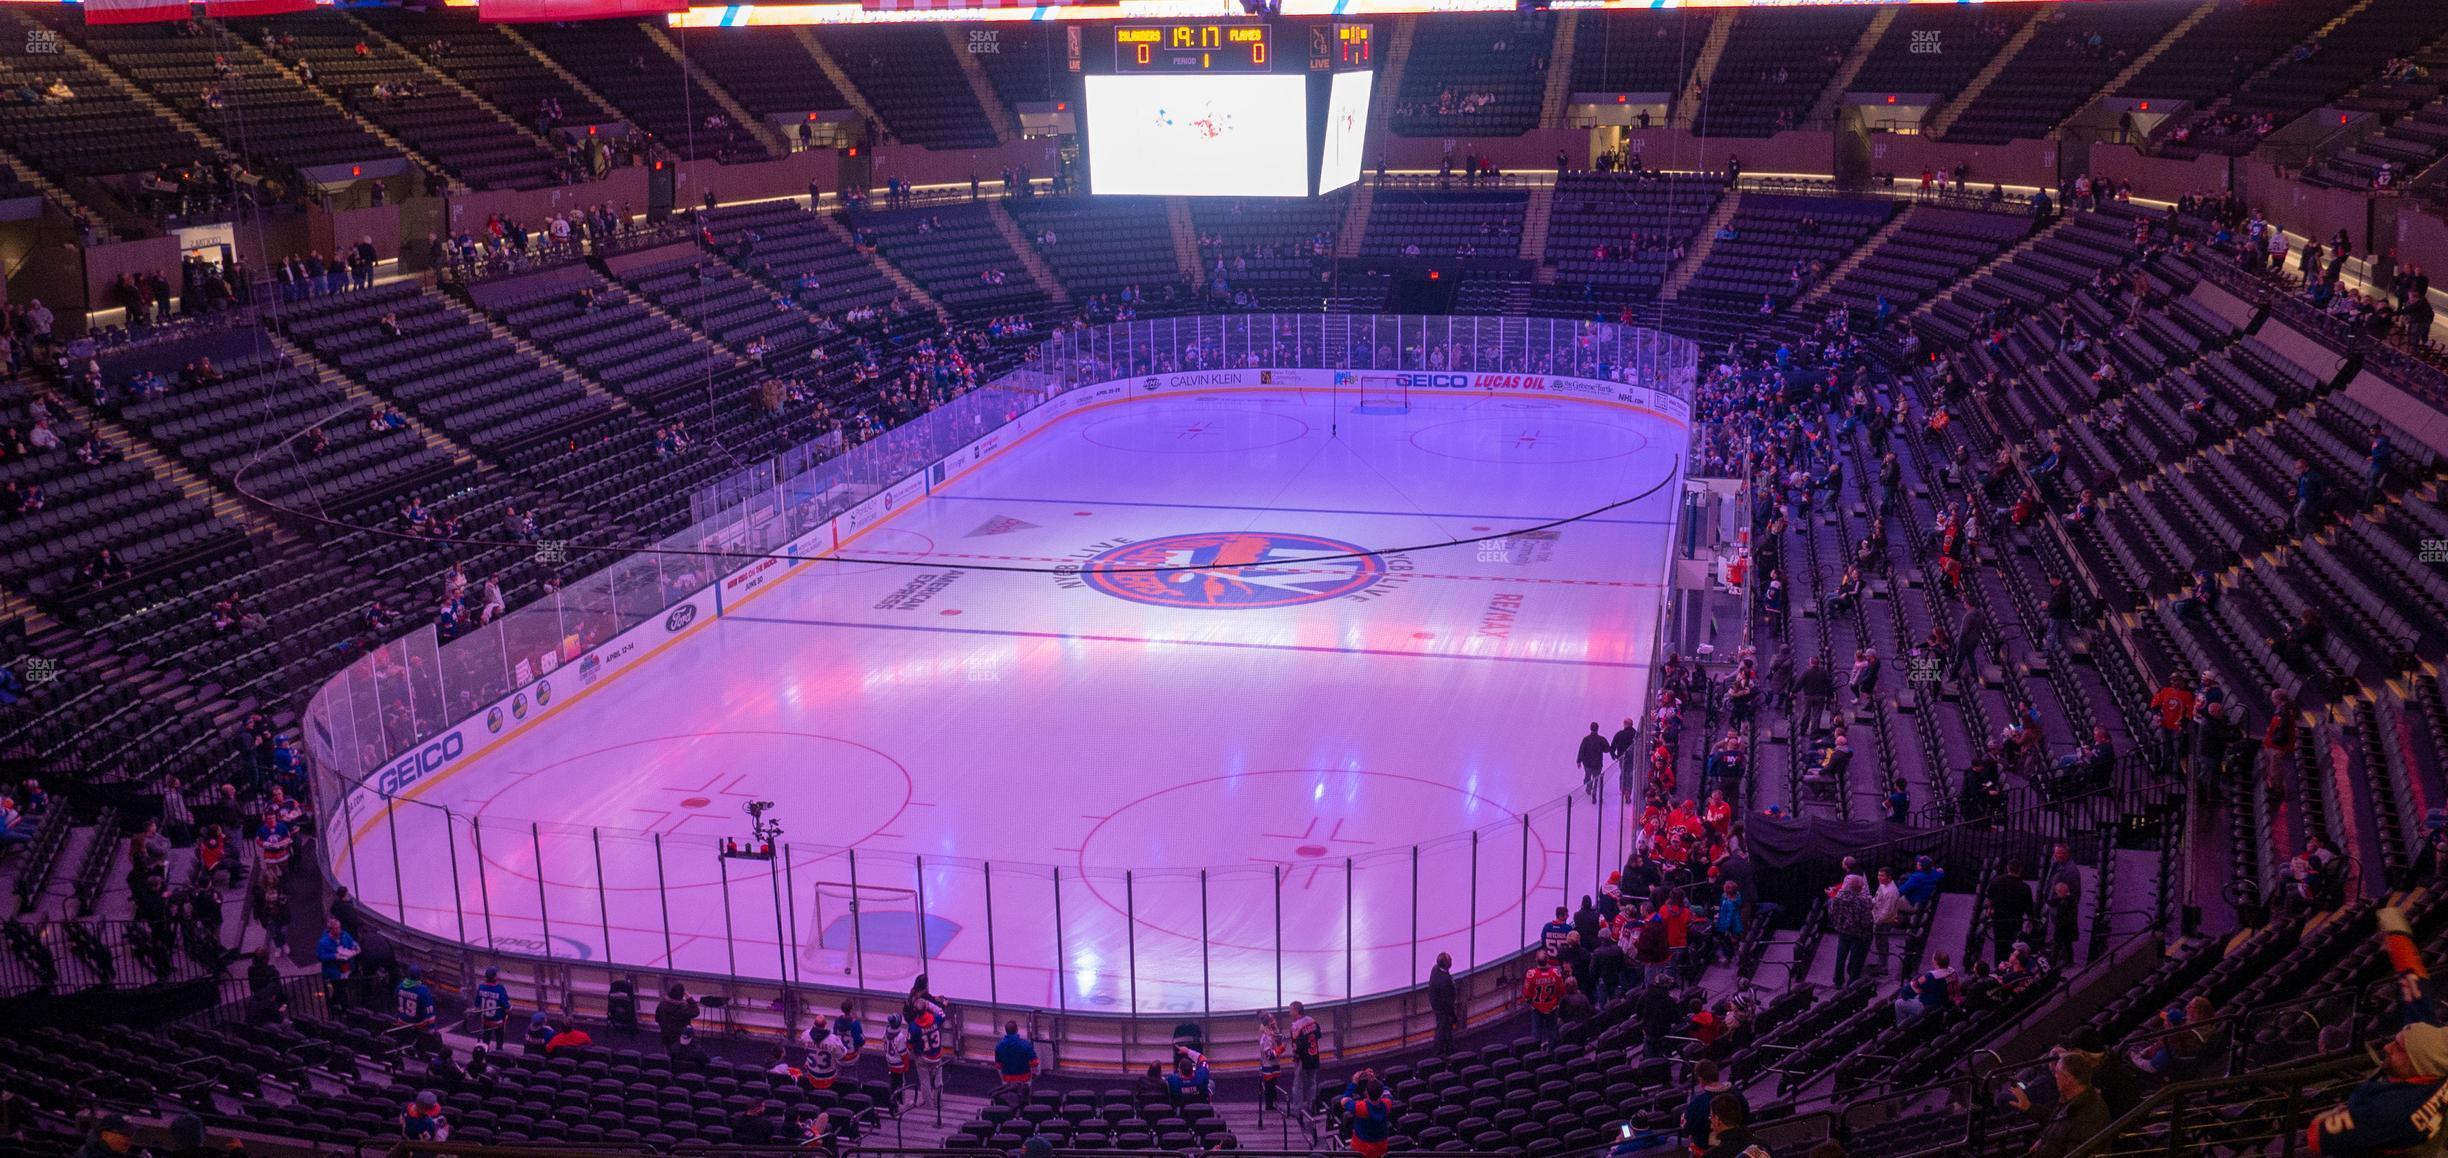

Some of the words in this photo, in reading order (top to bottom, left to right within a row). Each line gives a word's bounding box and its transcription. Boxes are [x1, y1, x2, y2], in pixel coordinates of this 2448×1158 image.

[1173, 26, 1219, 47] 19:17
[1137, 43, 1149, 64] 0
[1173, 57, 1197, 65] PERIOD
[1253, 43, 1265, 63] 0
[1310, 58, 1330, 69] LIVE
[1170, 375, 1209, 388] CALVIN
[1211, 373, 1242, 385] KLEIN
[1396, 374, 1468, 388] GEICO
[1474, 375, 1521, 389] LUCAS
[1523, 376, 1545, 390] OIL
[873, 574, 938, 610] EXPRESS
[896, 569, 965, 610] AMERICAN
[1477, 593, 1524, 639] RE/MAX
[605, 648, 621, 663] APRIL
[378, 731, 464, 801] GEICO
[1534, 985, 1555, 1003] 12
[398, 996, 417, 1017] 19
[921, 1030, 942, 1052] 13
[806, 1050, 832, 1070] 53
